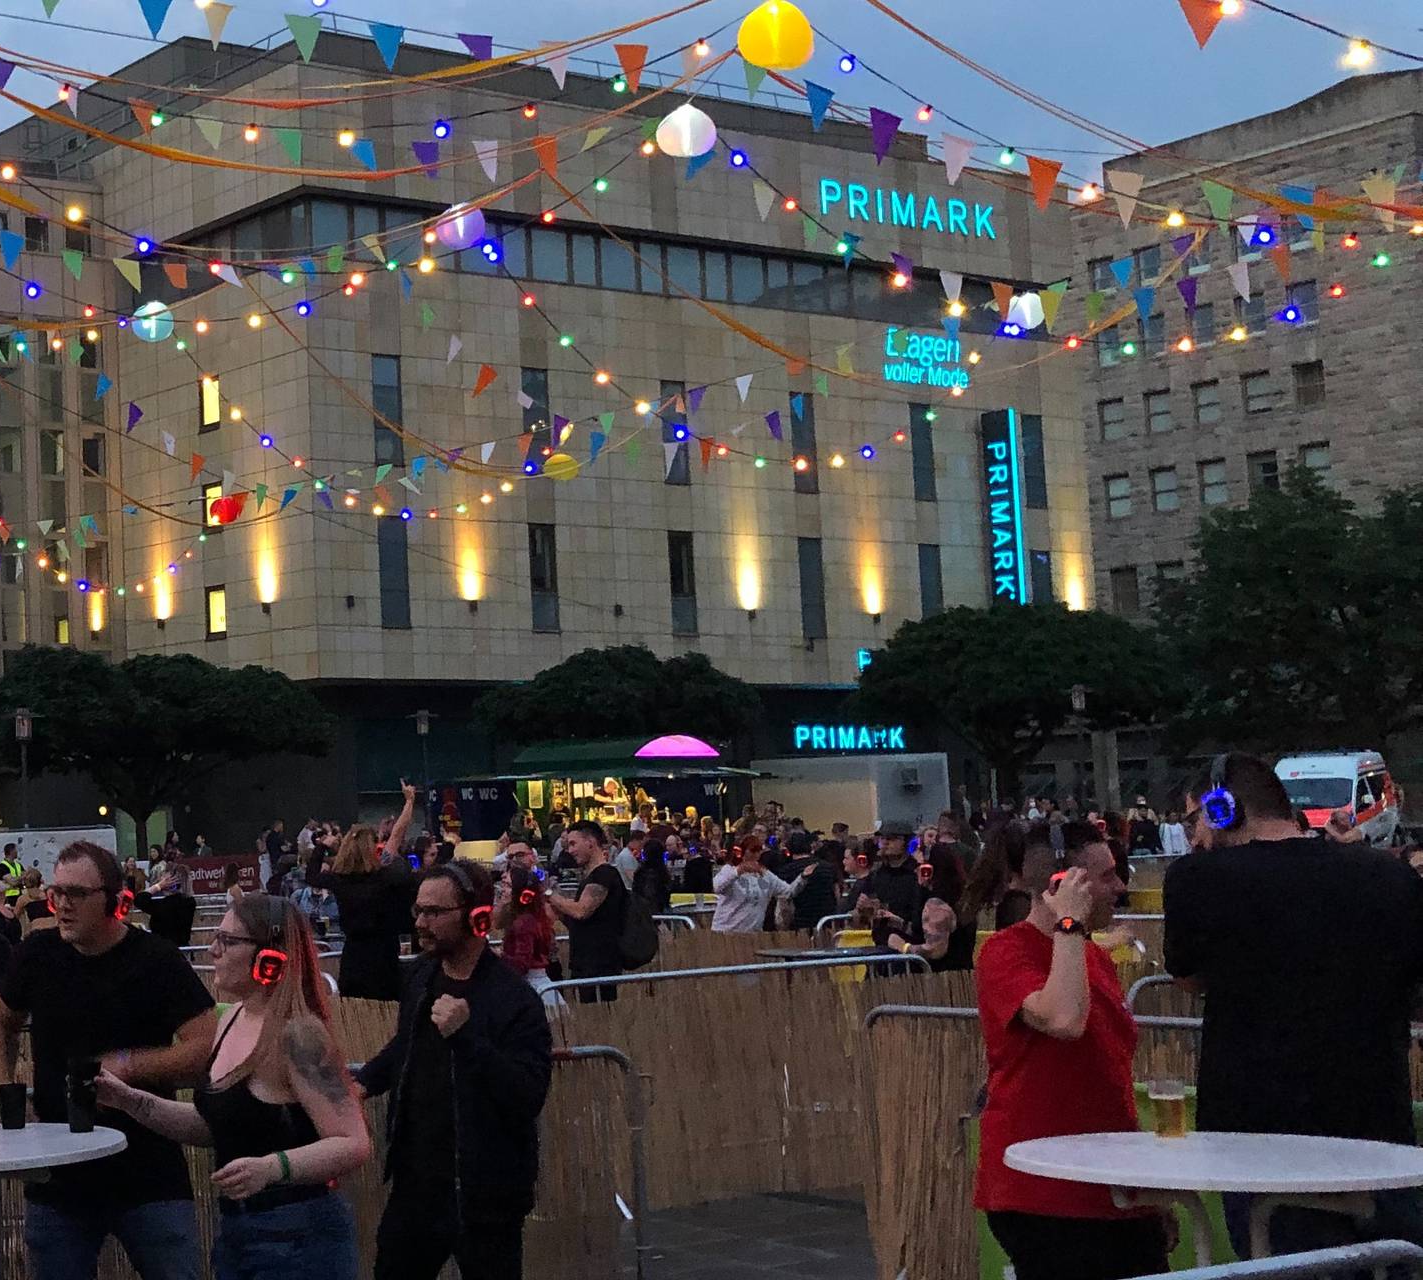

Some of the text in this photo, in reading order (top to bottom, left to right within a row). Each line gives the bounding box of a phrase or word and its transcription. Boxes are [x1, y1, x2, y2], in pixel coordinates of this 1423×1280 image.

[819, 177, 996, 240] PRIMARK
[886, 328, 960, 367] Eagen
[884, 362, 969, 390] voller Mode
[987, 441, 1017, 600] PRIMARK
[461, 787, 474, 801] WC
[479, 787, 498, 801] WC
